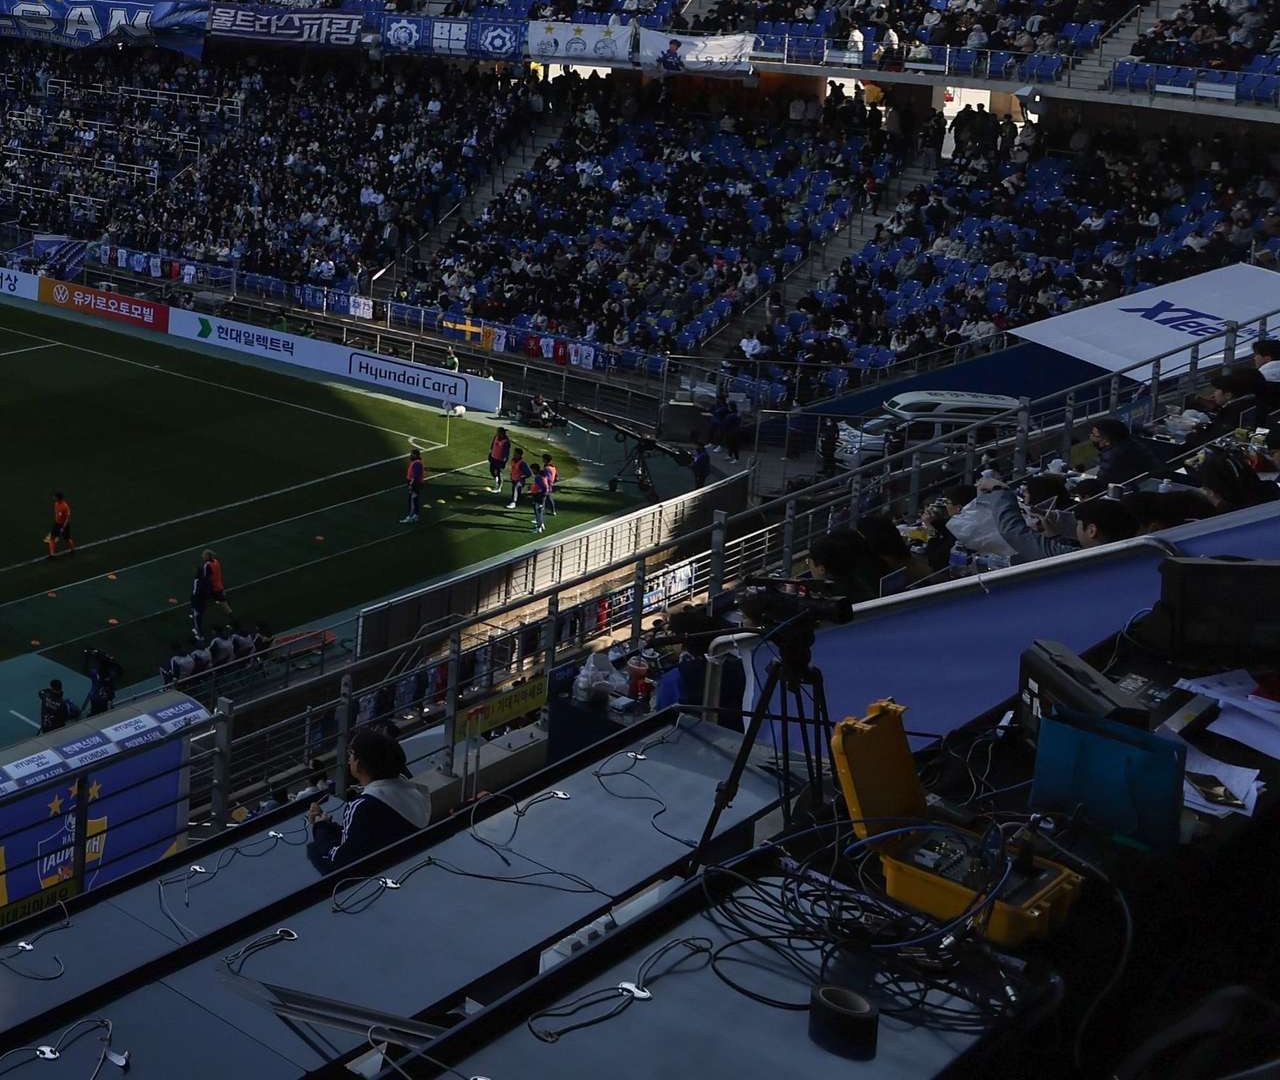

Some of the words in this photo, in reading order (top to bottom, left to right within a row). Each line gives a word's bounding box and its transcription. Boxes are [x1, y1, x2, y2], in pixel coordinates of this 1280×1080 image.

[72, 290, 155, 324] 유카로오토모빌
[216, 324, 295, 357] 현대일렉트릭
[358, 360, 420, 388] Hyundai
[421, 375, 458, 396] Card
